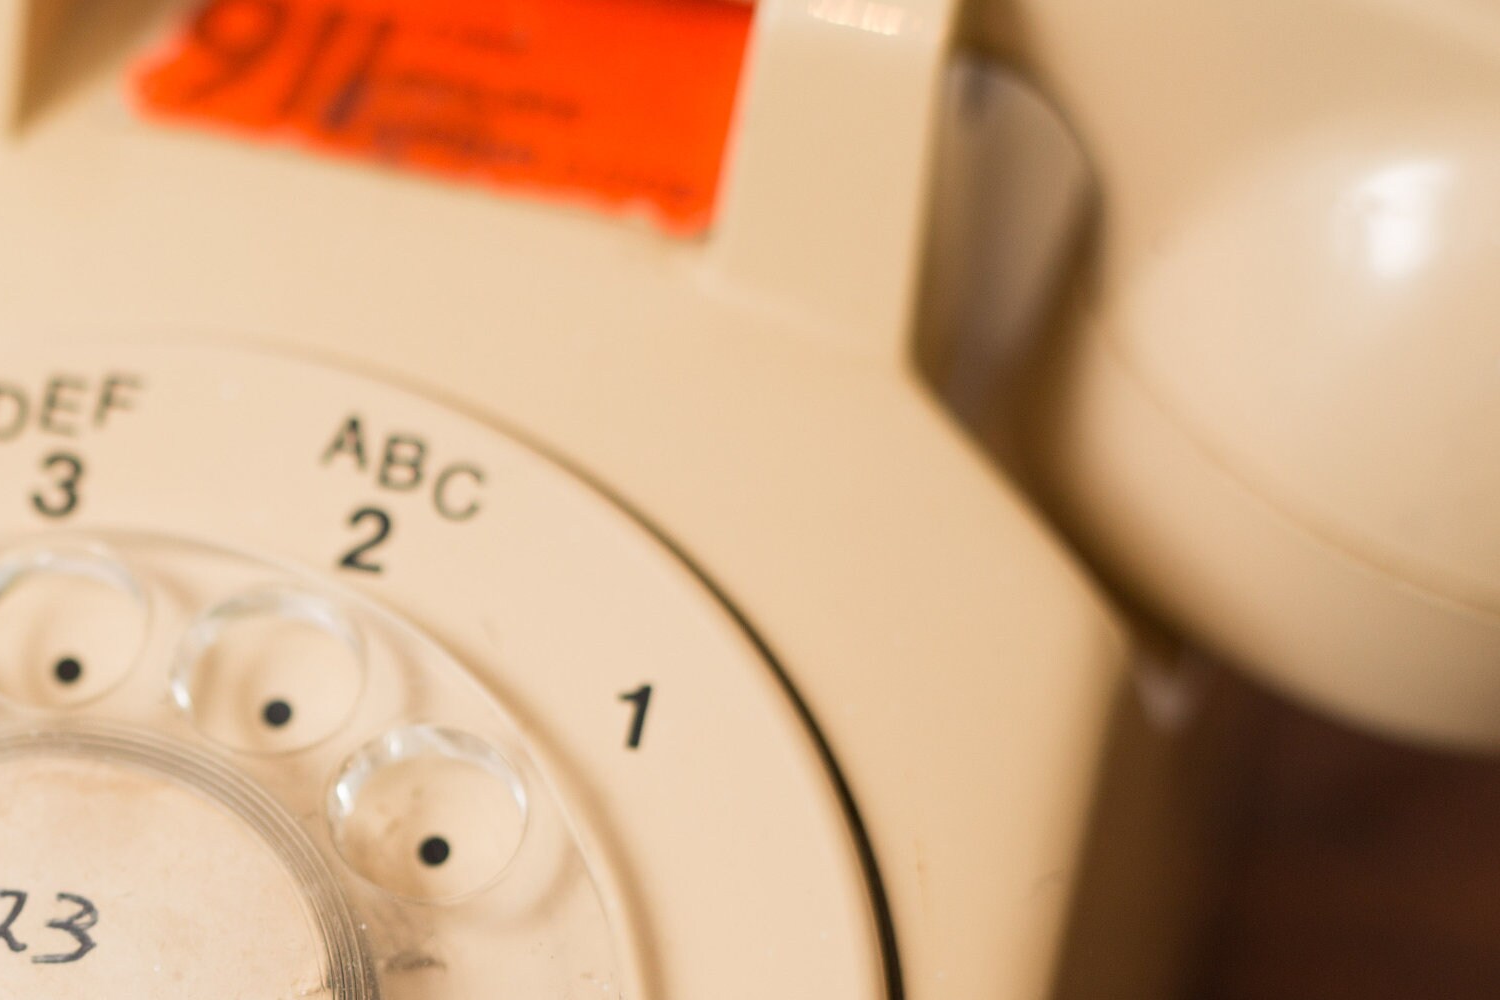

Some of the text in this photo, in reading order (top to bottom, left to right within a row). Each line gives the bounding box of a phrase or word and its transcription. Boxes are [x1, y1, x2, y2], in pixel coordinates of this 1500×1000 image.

[29, 450, 88, 520] 3
[321, 414, 486, 524] ABC
[337, 505, 395, 576] 2
[617, 682, 655, 752] 1
